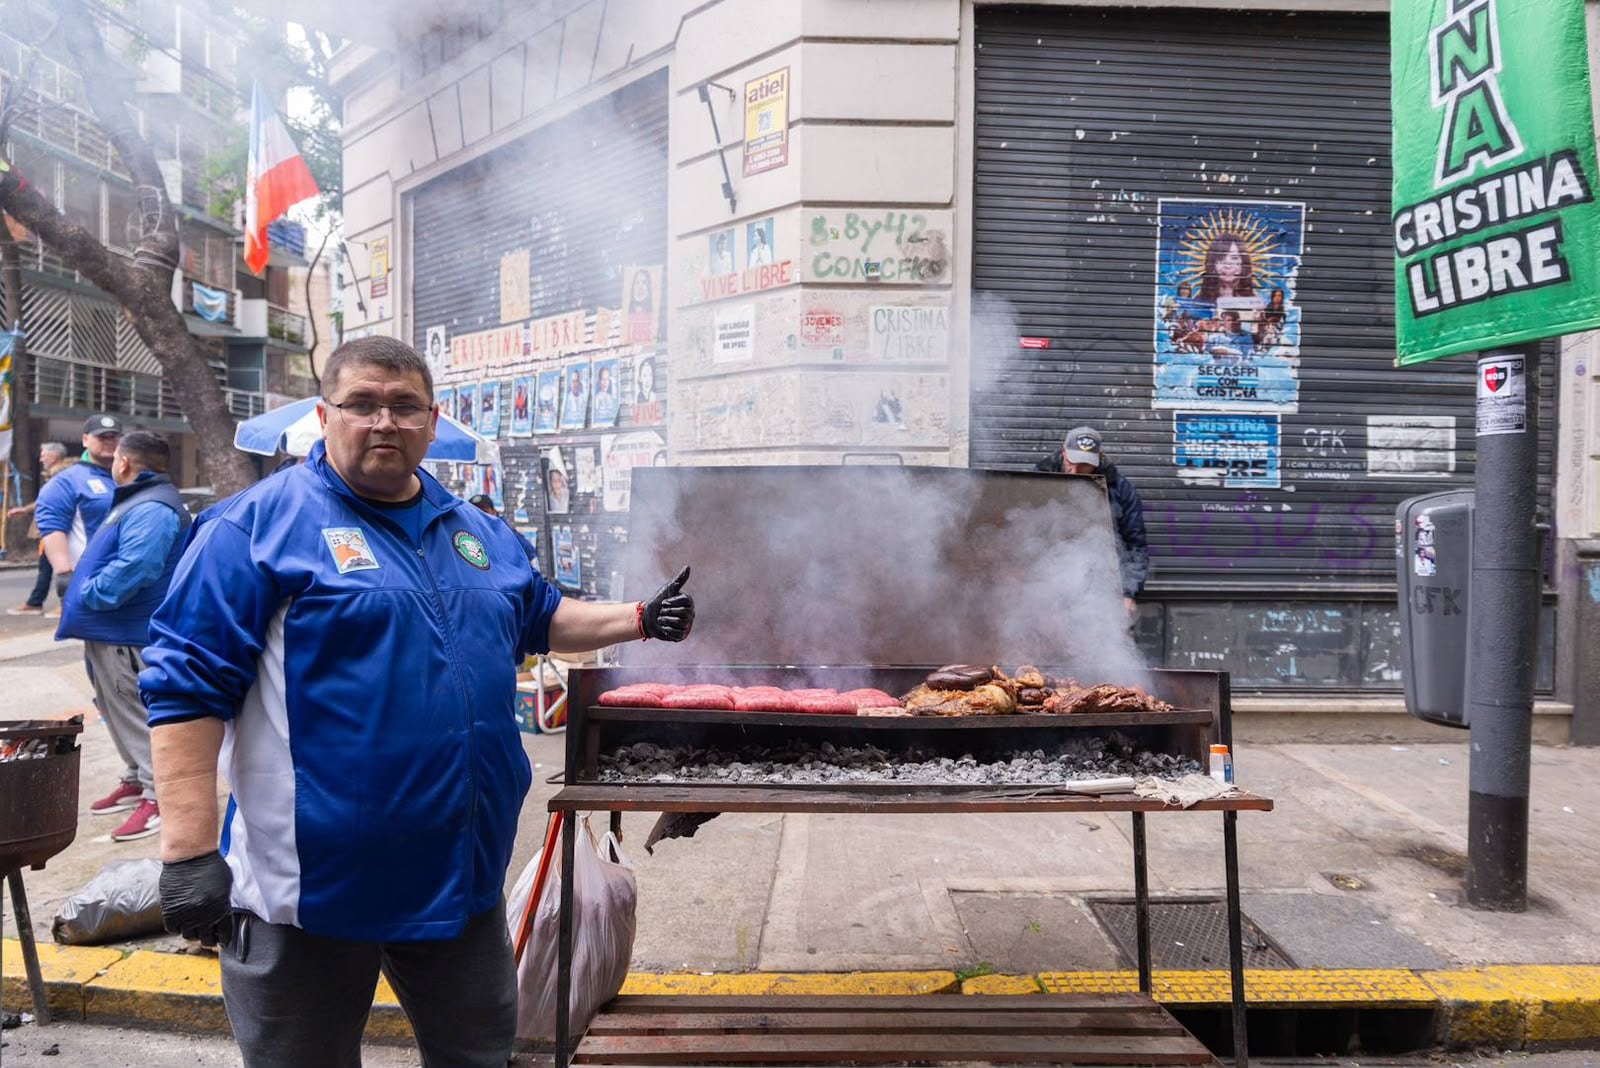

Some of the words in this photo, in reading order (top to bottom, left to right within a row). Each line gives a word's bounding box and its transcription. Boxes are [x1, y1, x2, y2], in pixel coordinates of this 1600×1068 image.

[748, 73, 785, 104] atiel
[1430, 0, 1525, 190] NA
[1394, 157, 1584, 253] CRISTINA
[702, 272, 738, 300] VIVE
[742, 260, 791, 291] LIBRE
[1408, 225, 1563, 313] LIBRE
[805, 317, 841, 327] JOVENES
[873, 307, 947, 333] CRISTINA
[452, 326, 521, 365] CRISTINA
[533, 316, 580, 352] LIBRE
[883, 334, 938, 359] LIBRE
[1196, 386, 1257, 399] CRISTINA
[1217, 377, 1239, 387] CON
[1185, 418, 1268, 433] CRISTINA
